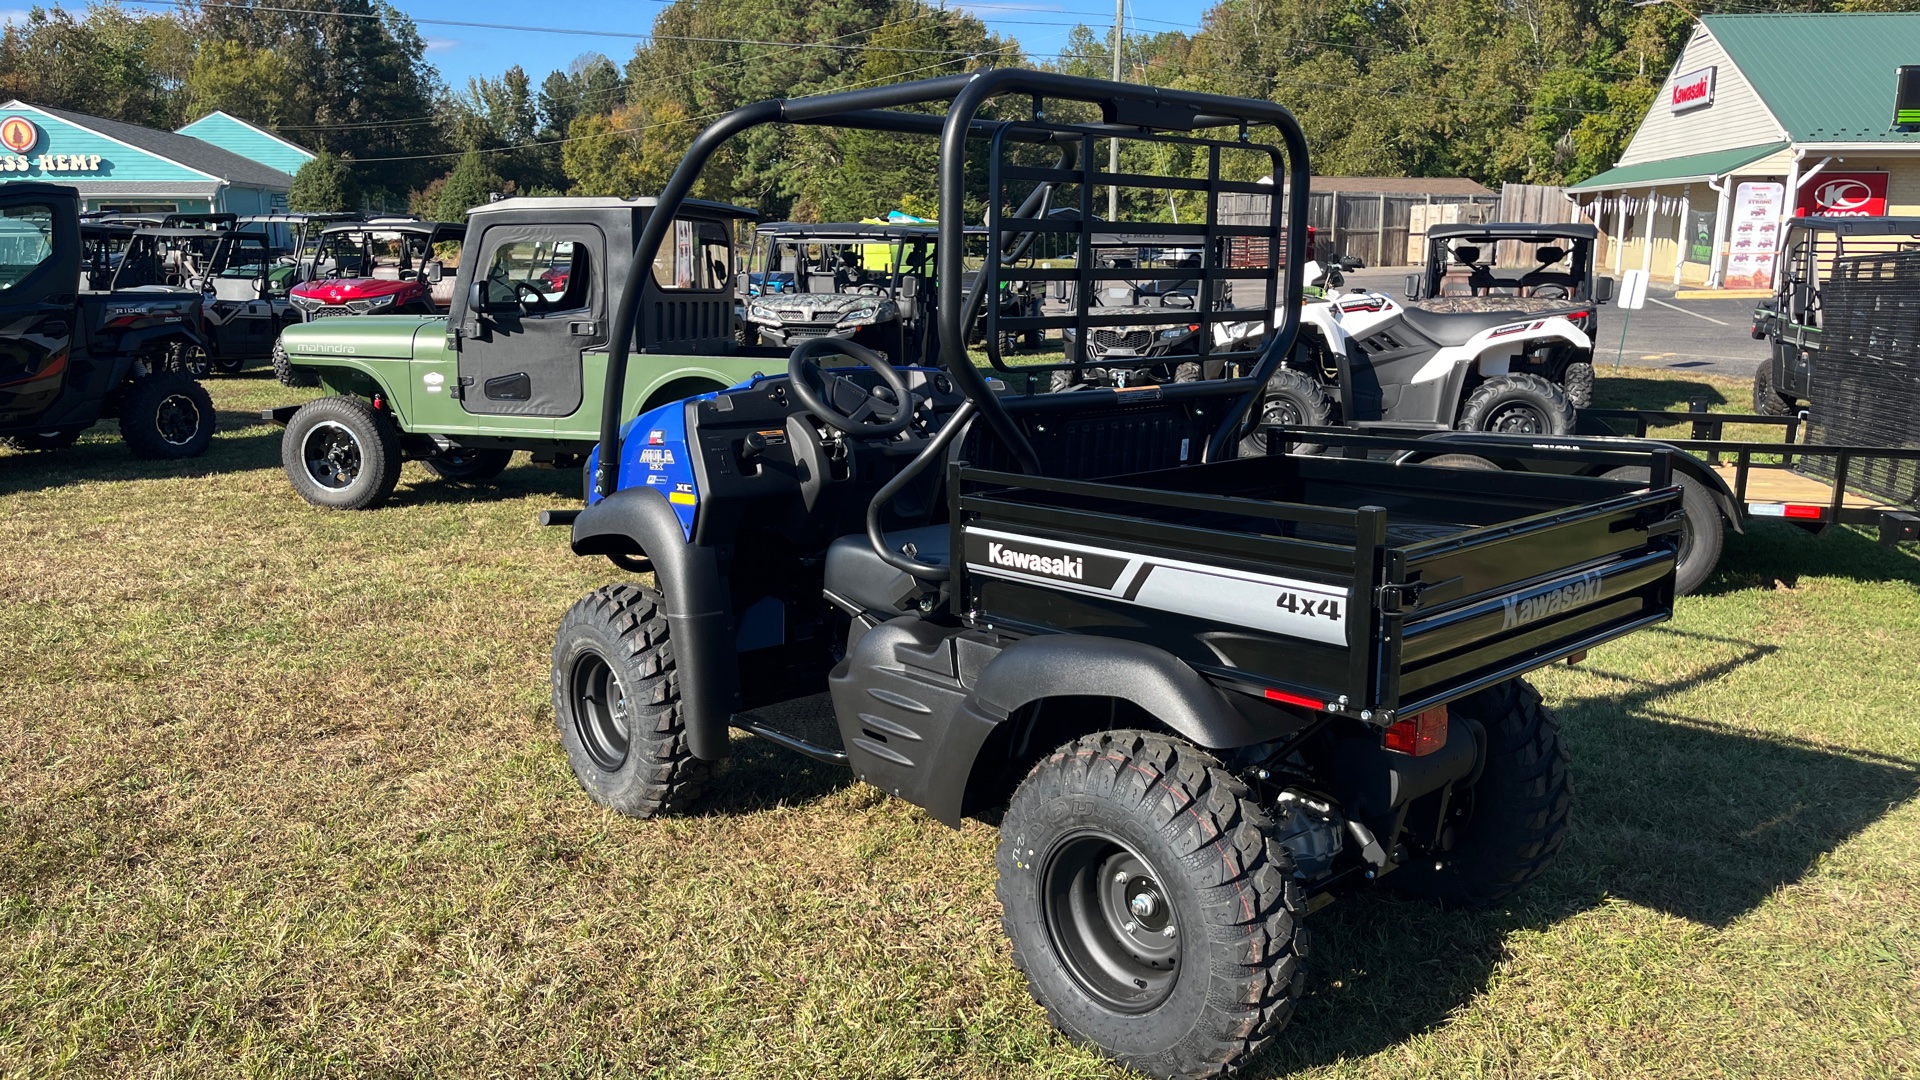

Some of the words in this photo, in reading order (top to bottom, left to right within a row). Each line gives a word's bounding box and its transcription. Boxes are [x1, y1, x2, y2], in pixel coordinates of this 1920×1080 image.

[1672, 76, 1708, 105] Kawasaki
[0, 154, 29, 171] SS
[39, 154, 102, 171] HEMP
[297, 343, 356, 354] mahindra
[639, 448, 675, 465] MULE
[676, 483, 693, 493] XC
[988, 541, 1083, 580] Kawasaki
[1276, 591, 1342, 621] 4x4
[1501, 570, 1602, 632] Kawasaki
